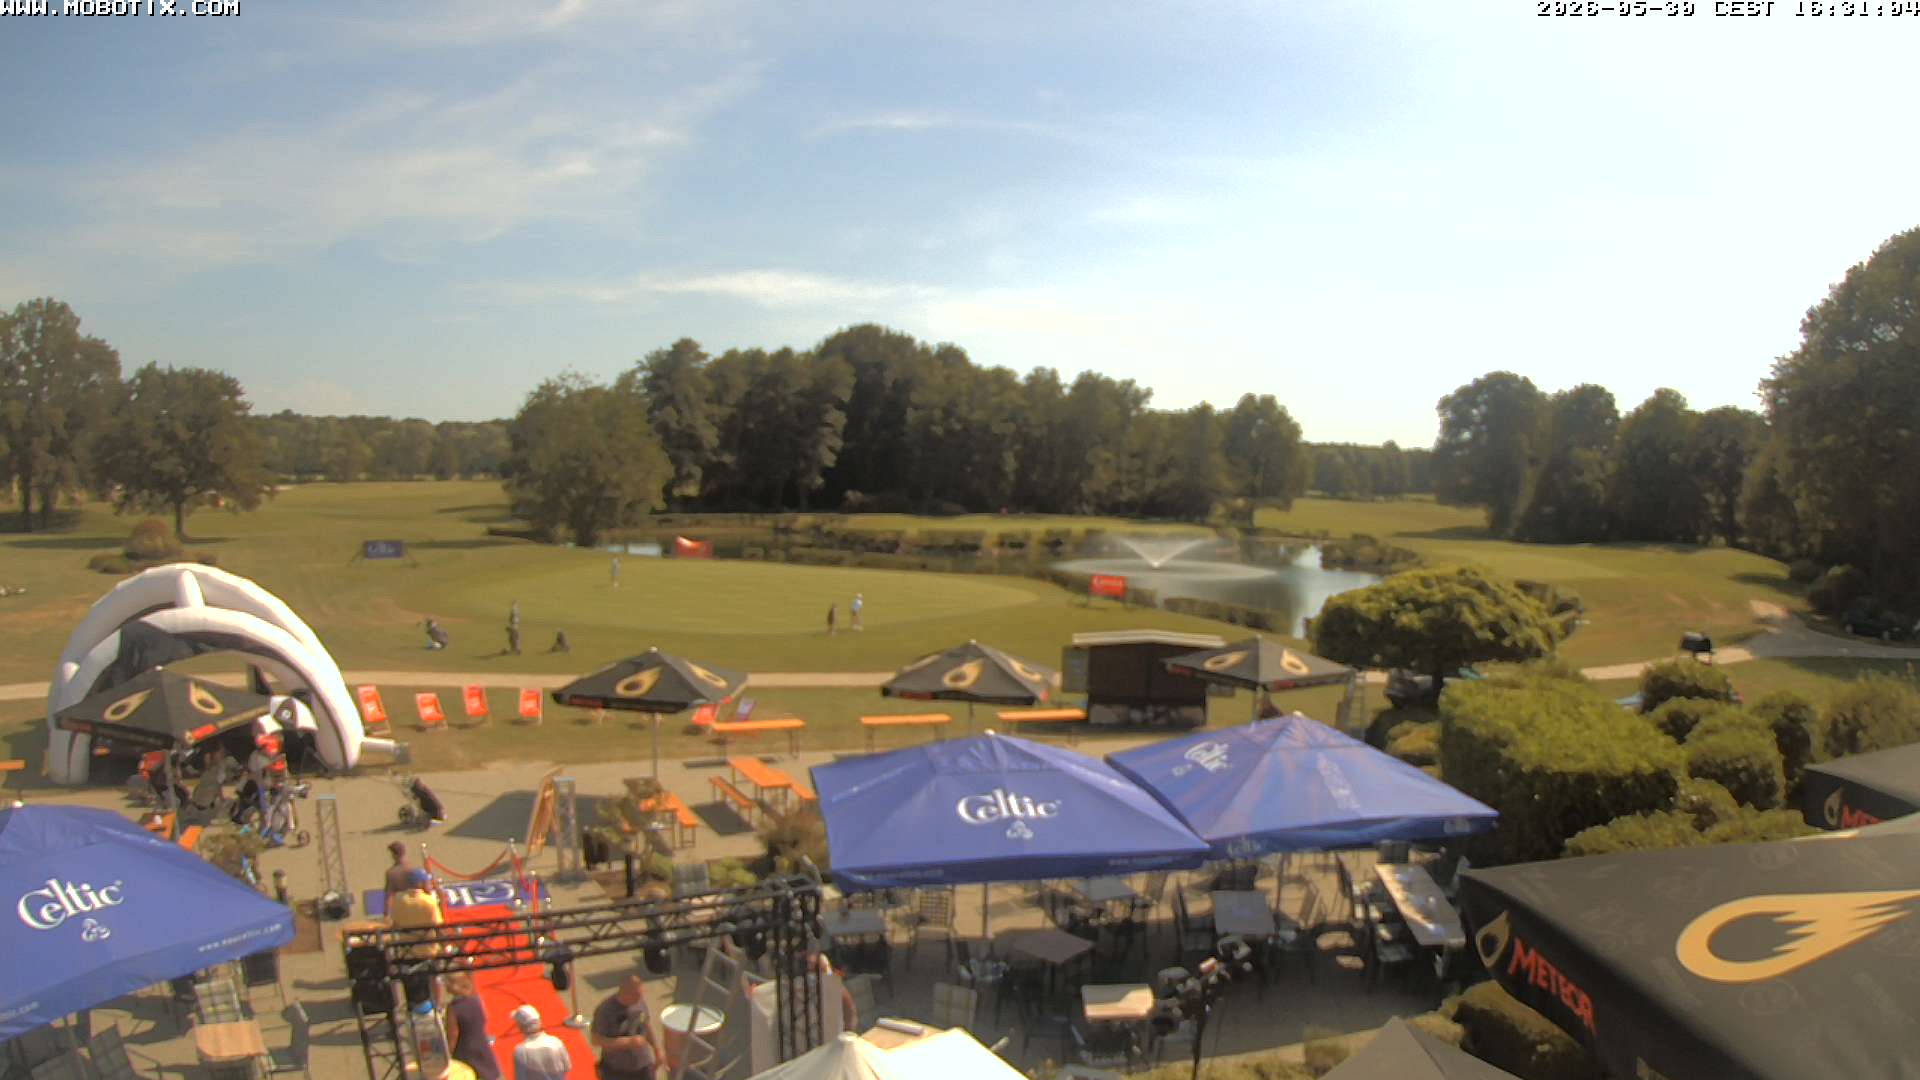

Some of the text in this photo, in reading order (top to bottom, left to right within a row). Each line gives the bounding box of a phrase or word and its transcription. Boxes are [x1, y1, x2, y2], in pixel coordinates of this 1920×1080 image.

[956, 789, 1059, 826] Celtic
[17, 879, 124, 930] Celtic
[1508, 937, 1598, 1036] METEOR
